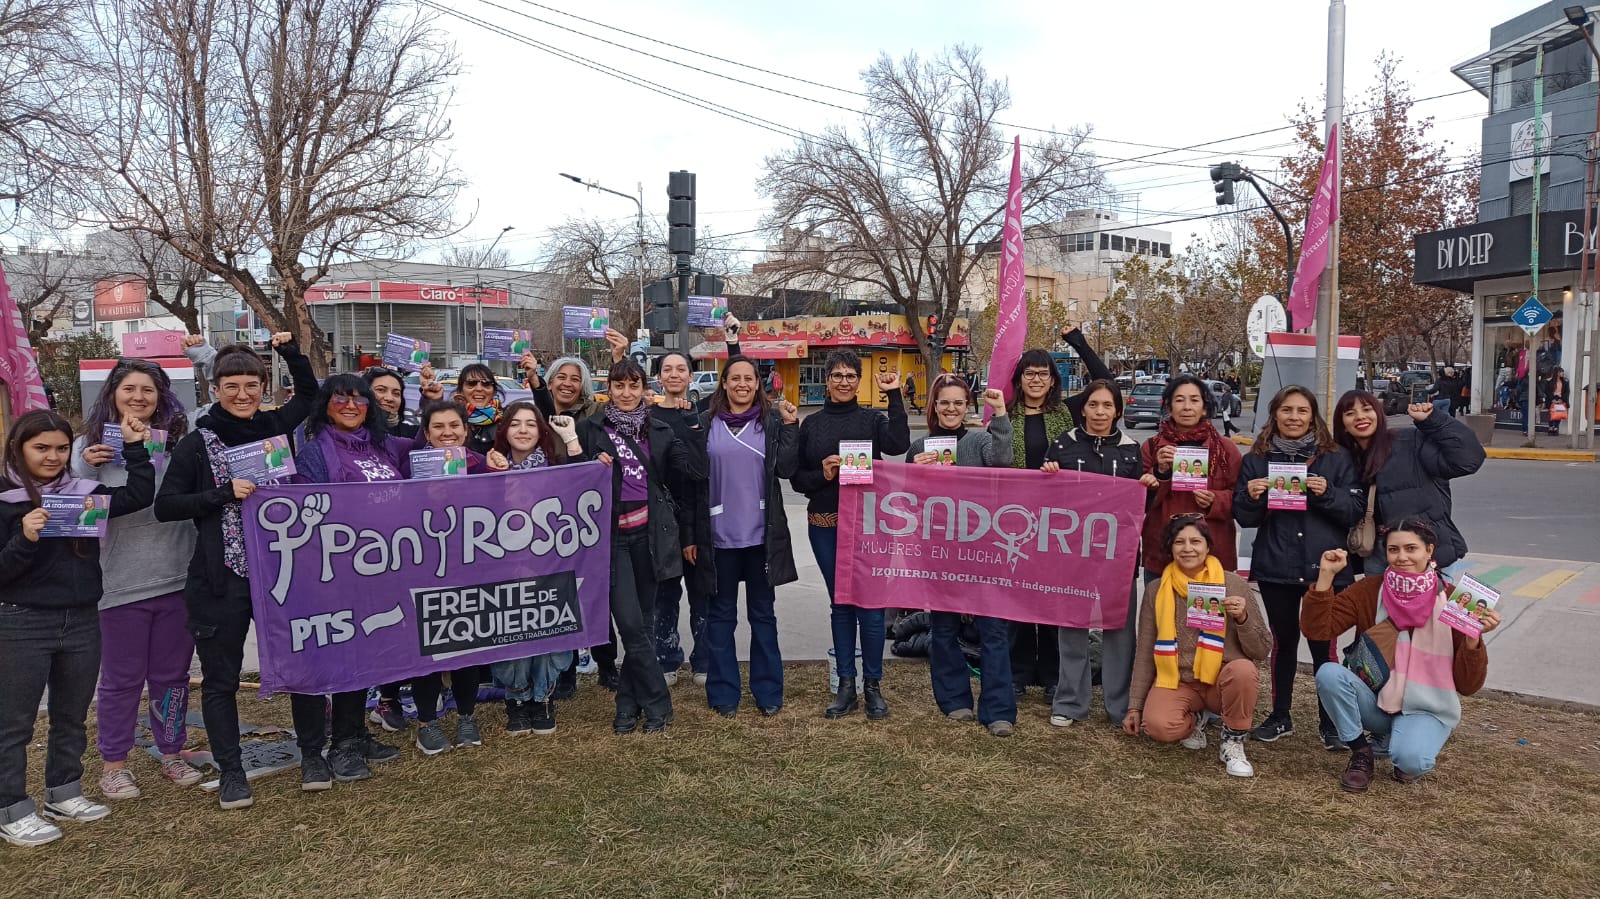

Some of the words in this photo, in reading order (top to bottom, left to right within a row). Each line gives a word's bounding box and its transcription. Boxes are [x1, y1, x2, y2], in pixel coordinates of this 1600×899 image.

[1437, 238, 1455, 270] BY
[1458, 233, 1494, 266] DEEP
[420, 286, 460, 301] Claro
[862, 491, 1119, 562] ISADORA
[861, 541, 922, 557] MUJERES
[931, 546, 950, 560] EN
[958, 548, 1002, 565] LUCHA
[421, 580, 537, 619] FRENTE
[538, 588, 559, 604] DE
[871, 567, 938, 580] IZQUIERDA
[941, 571, 1013, 588] SOCIALISTA
[1021, 579, 1101, 600] independientes
[290, 610, 356, 653] PTS
[422, 601, 578, 647] IZQUIERDA
[509, 634, 524, 642] LOS
[525, 624, 578, 640] TRABAJADORES
